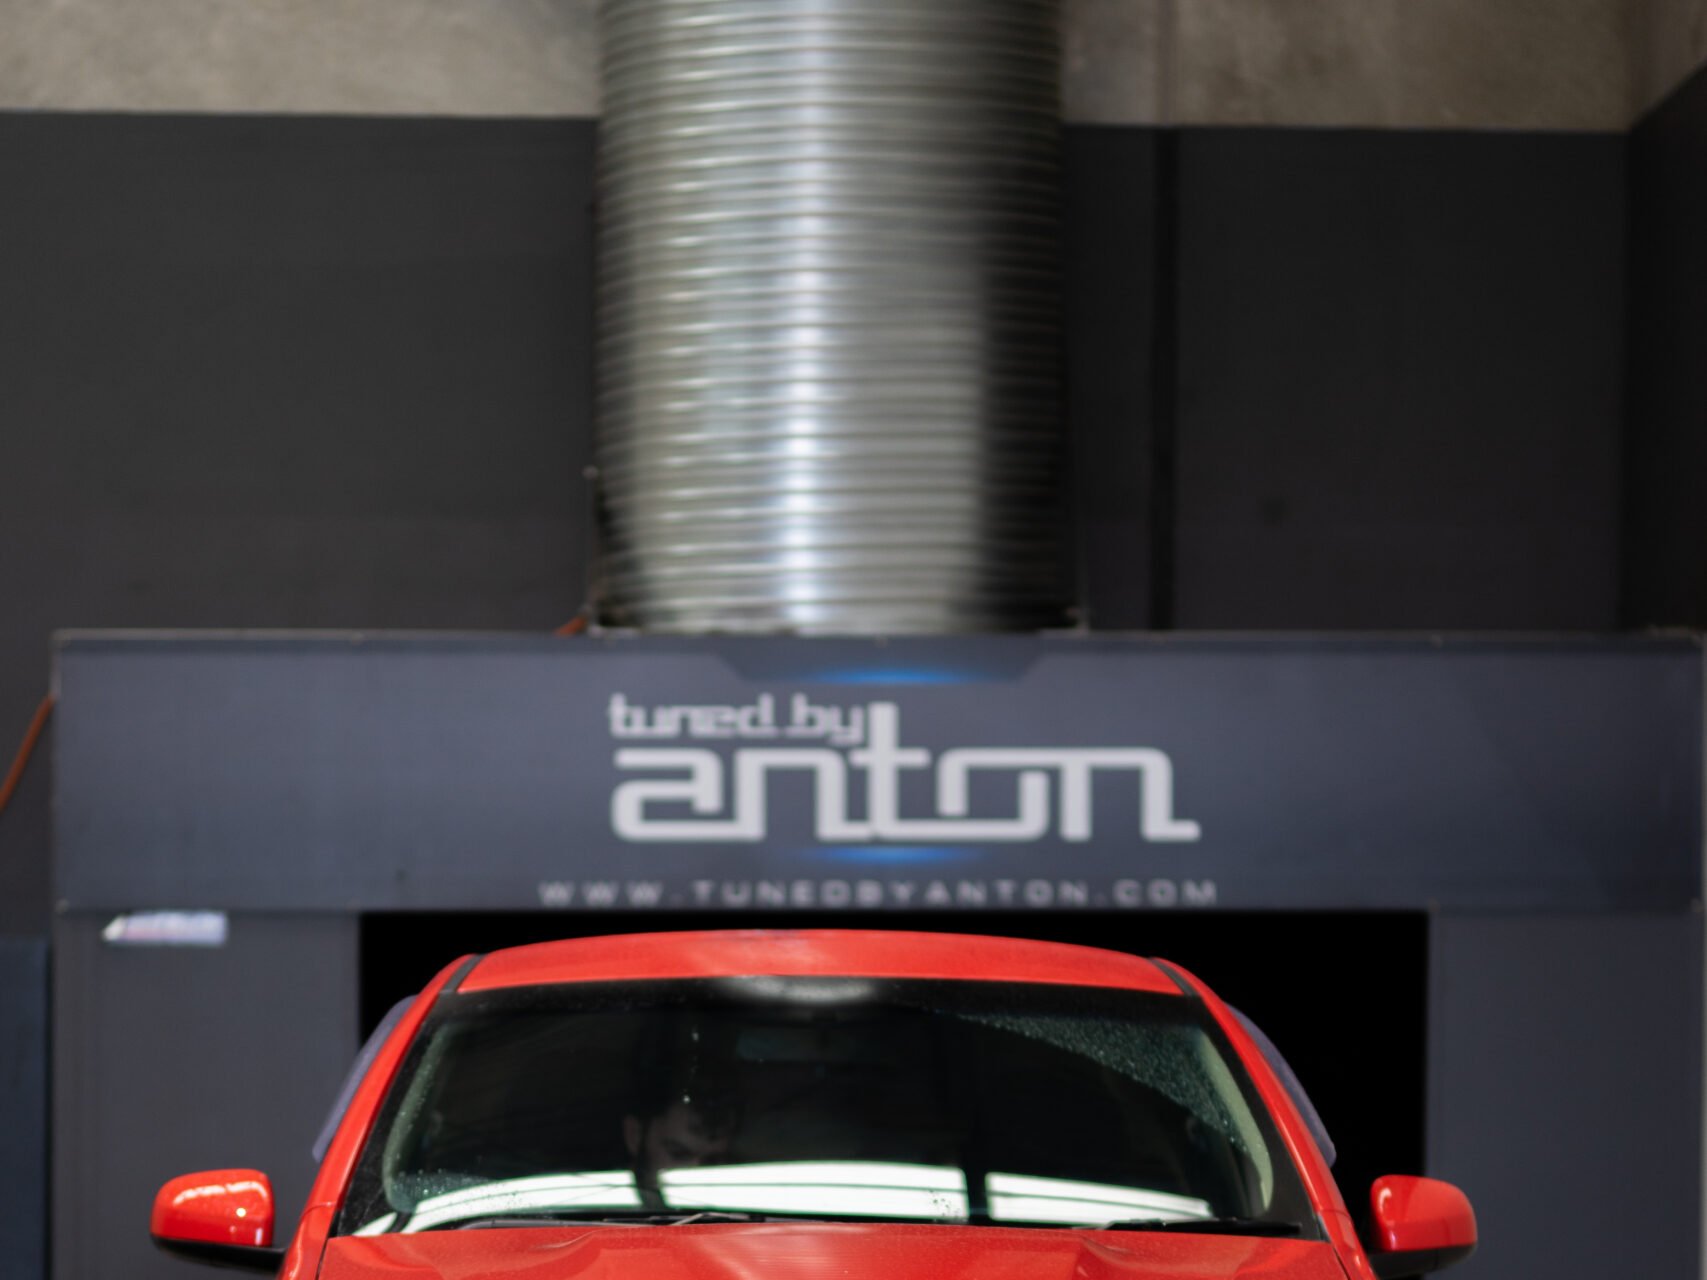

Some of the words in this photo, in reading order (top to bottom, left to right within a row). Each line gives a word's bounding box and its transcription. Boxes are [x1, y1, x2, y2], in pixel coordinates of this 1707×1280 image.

[609, 692, 778, 738] tuned
[786, 692, 865, 745] by
[612, 701, 1201, 842] anton
[538, 879, 1217, 908] WWW.TUNEDBYANTON.COM
